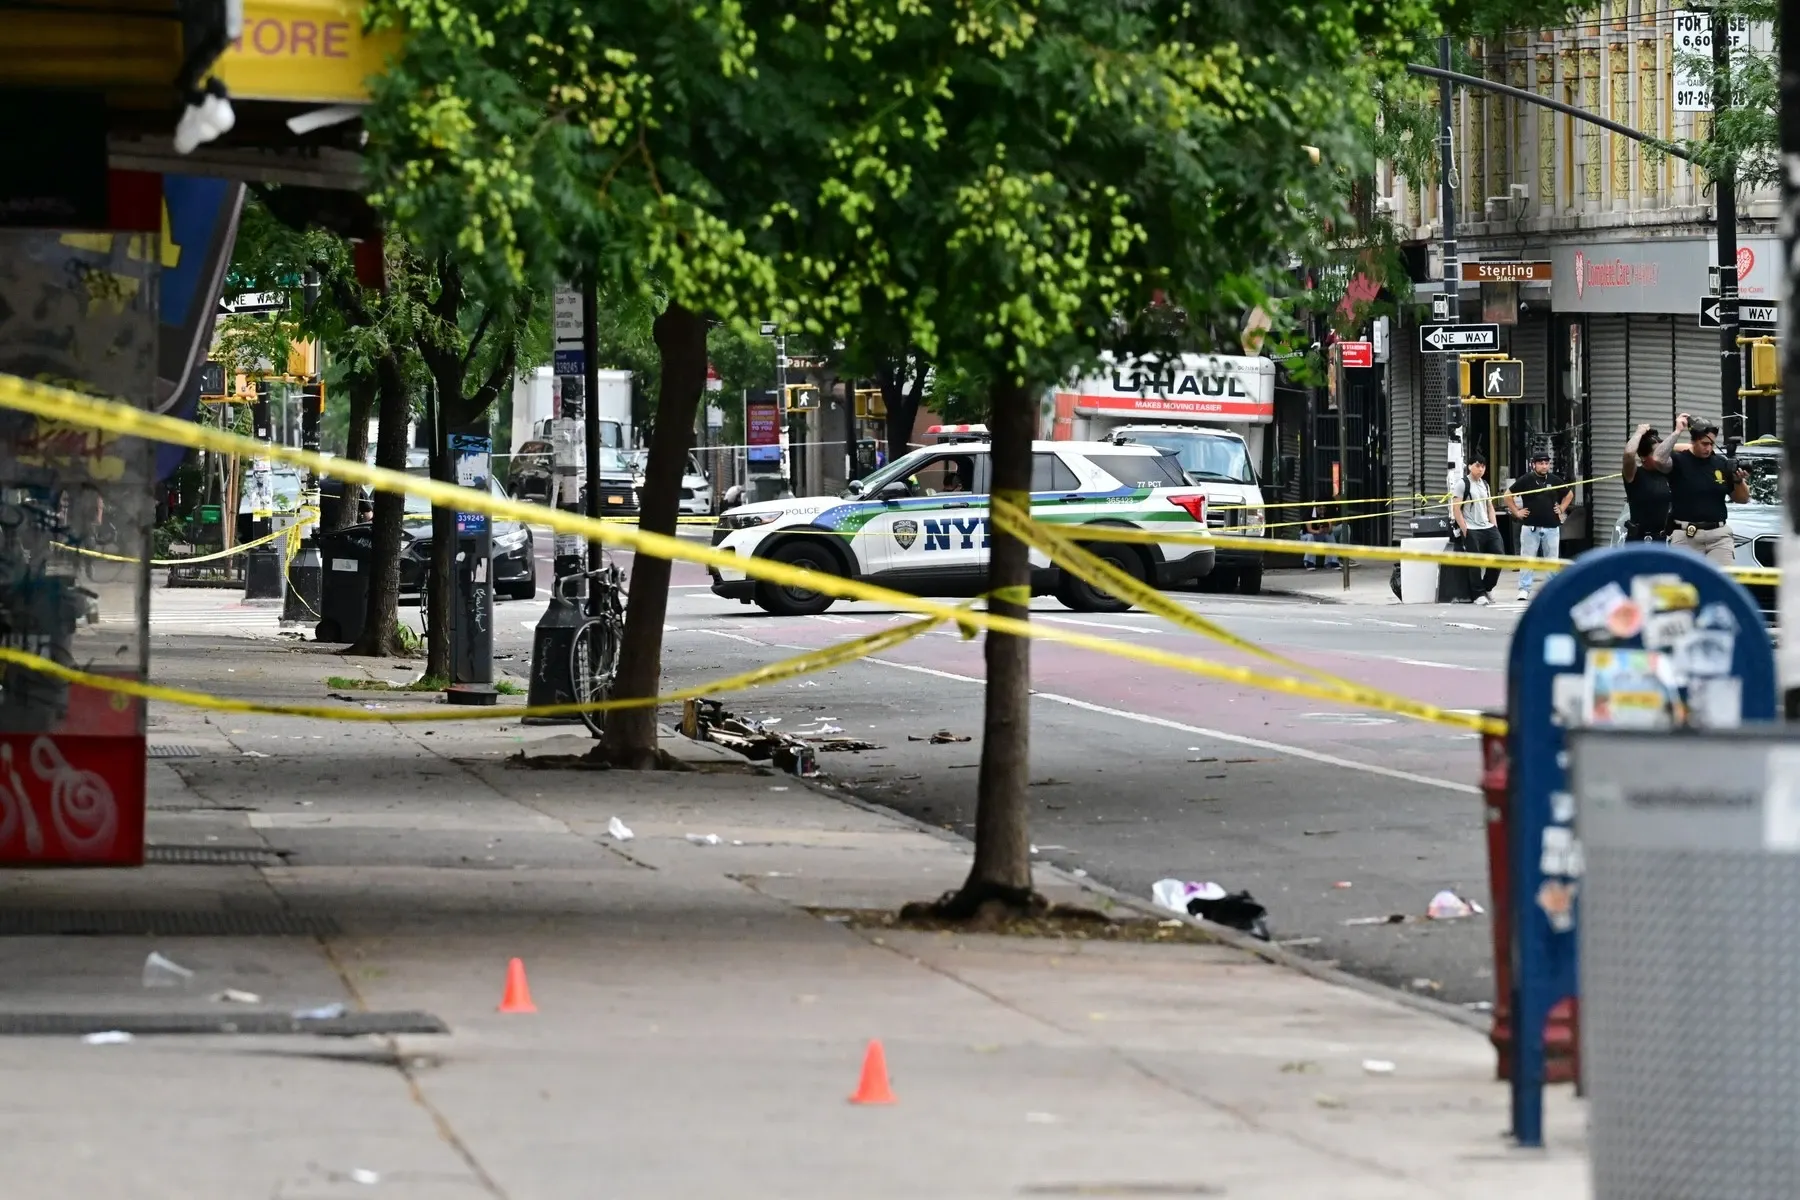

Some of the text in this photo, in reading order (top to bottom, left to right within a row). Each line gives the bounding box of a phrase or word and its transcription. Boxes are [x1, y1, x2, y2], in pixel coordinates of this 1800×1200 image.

[1677, 16, 1746, 31] FOR LSE
[1683, 36, 1712, 48] 6,60
[1479, 264, 1534, 279] Sterling
[1748, 308, 1773, 320] WAY
[1433, 332, 1489, 344] ONE WAY
[1135, 401, 1161, 409] MAKES
[1163, 402, 1194, 411] MOVING
[1148, 480, 1162, 488] PCT
[785, 506, 820, 516] POLICE
[458, 514, 485, 522] 339245
